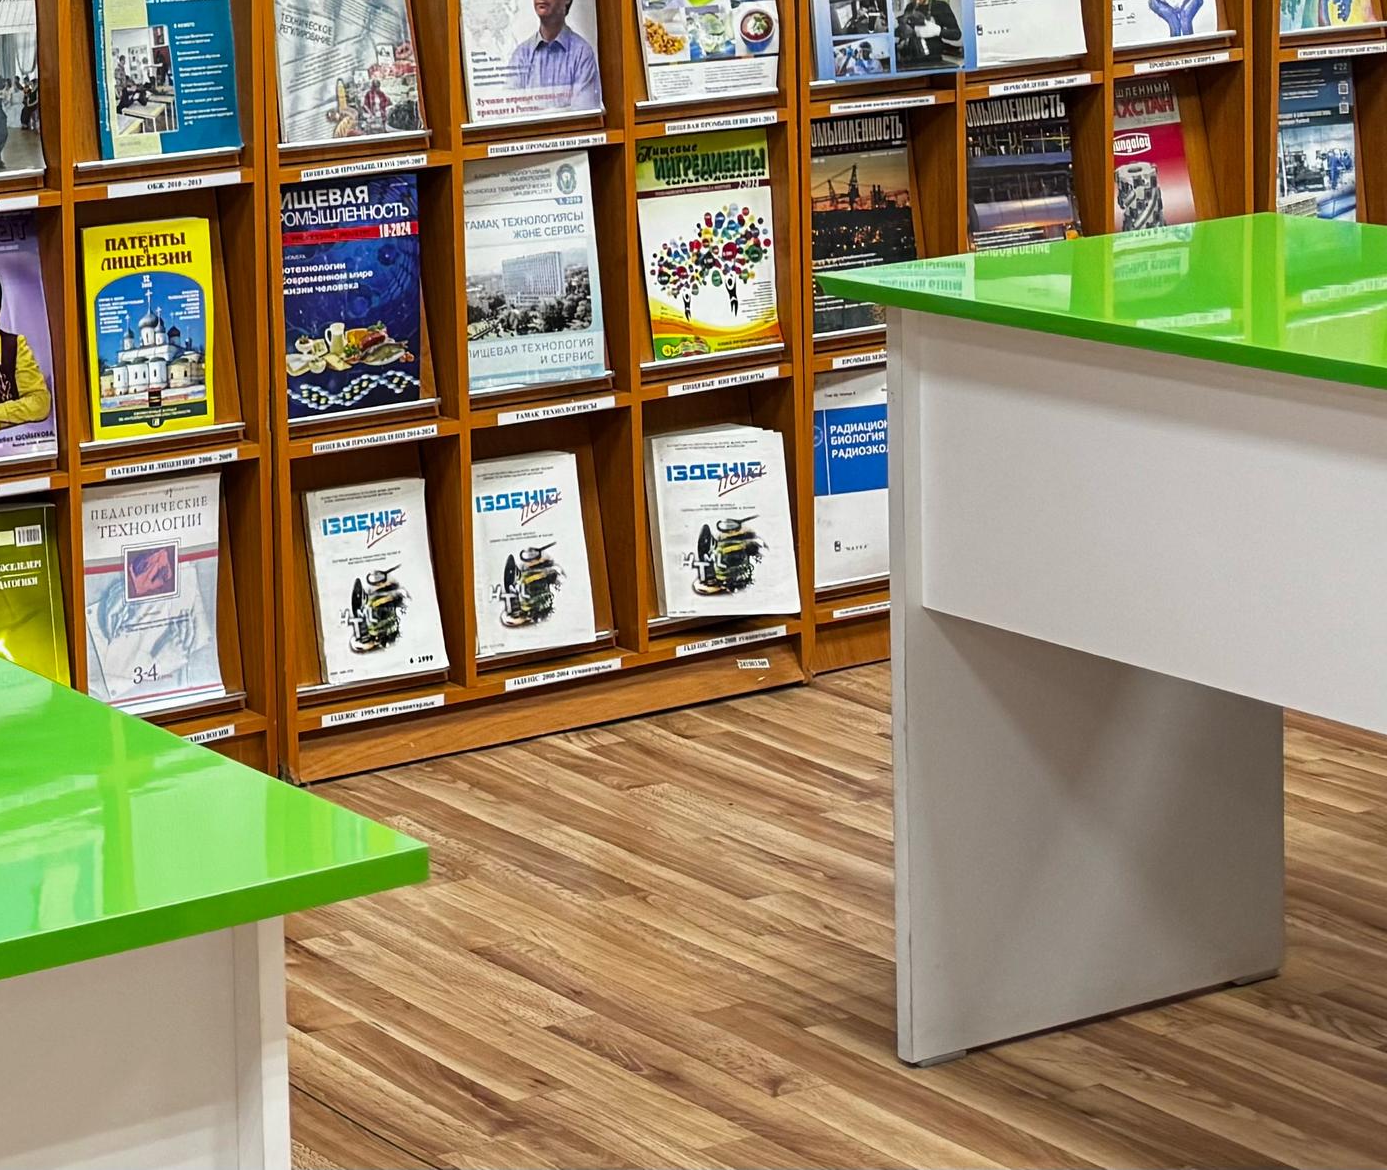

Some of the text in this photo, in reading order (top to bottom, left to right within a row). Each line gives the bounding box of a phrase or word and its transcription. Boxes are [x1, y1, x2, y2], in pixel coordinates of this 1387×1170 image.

[653, 149, 765, 180] ИНГРЕДИЕНТЫ
[502, 211, 583, 226] ТЕХНОЛОГИЯСЫ
[514, 224, 585, 238] ЖӘНЕ СЕРВИС
[105, 232, 186, 252] ПАТЕНТЫ
[101, 250, 192, 271] ЛИЦЕНЗИИ
[522, 337, 595, 354] ТЕХНОЛОГИЯ
[540, 349, 595, 363] И СЕРВИС
[831, 431, 885, 445] БИОЛОГИЯ
[111, 466, 147, 476] ПАТЕНТЫ
[91, 496, 208, 521] ПЕДАГОГИЧЕСКИЕ
[97, 513, 202, 540] ТЕХНОЛОГИИ
[133, 663, 158, 685] 3-4
